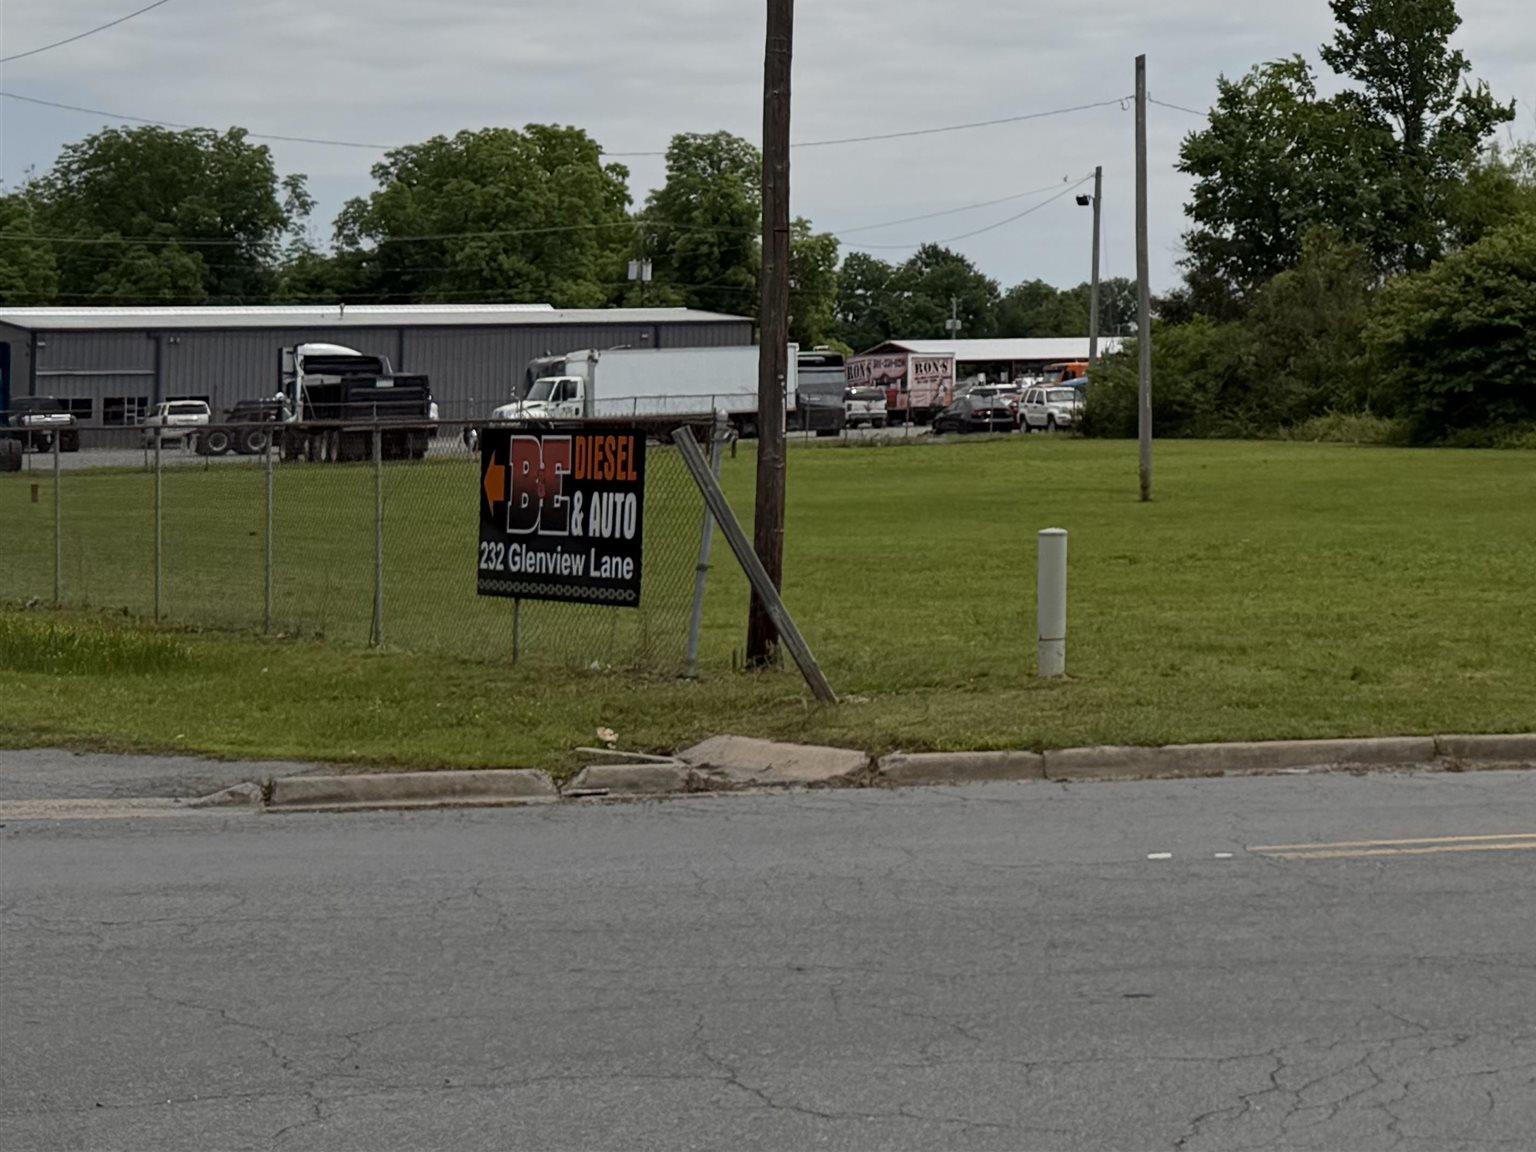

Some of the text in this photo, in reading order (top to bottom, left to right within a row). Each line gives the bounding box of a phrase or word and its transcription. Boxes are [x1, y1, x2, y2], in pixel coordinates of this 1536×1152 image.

[575, 435, 637, 481] DIESEL
[571, 491, 637, 540] & AUTO
[480, 541, 634, 580] 232 Glenview Lane
